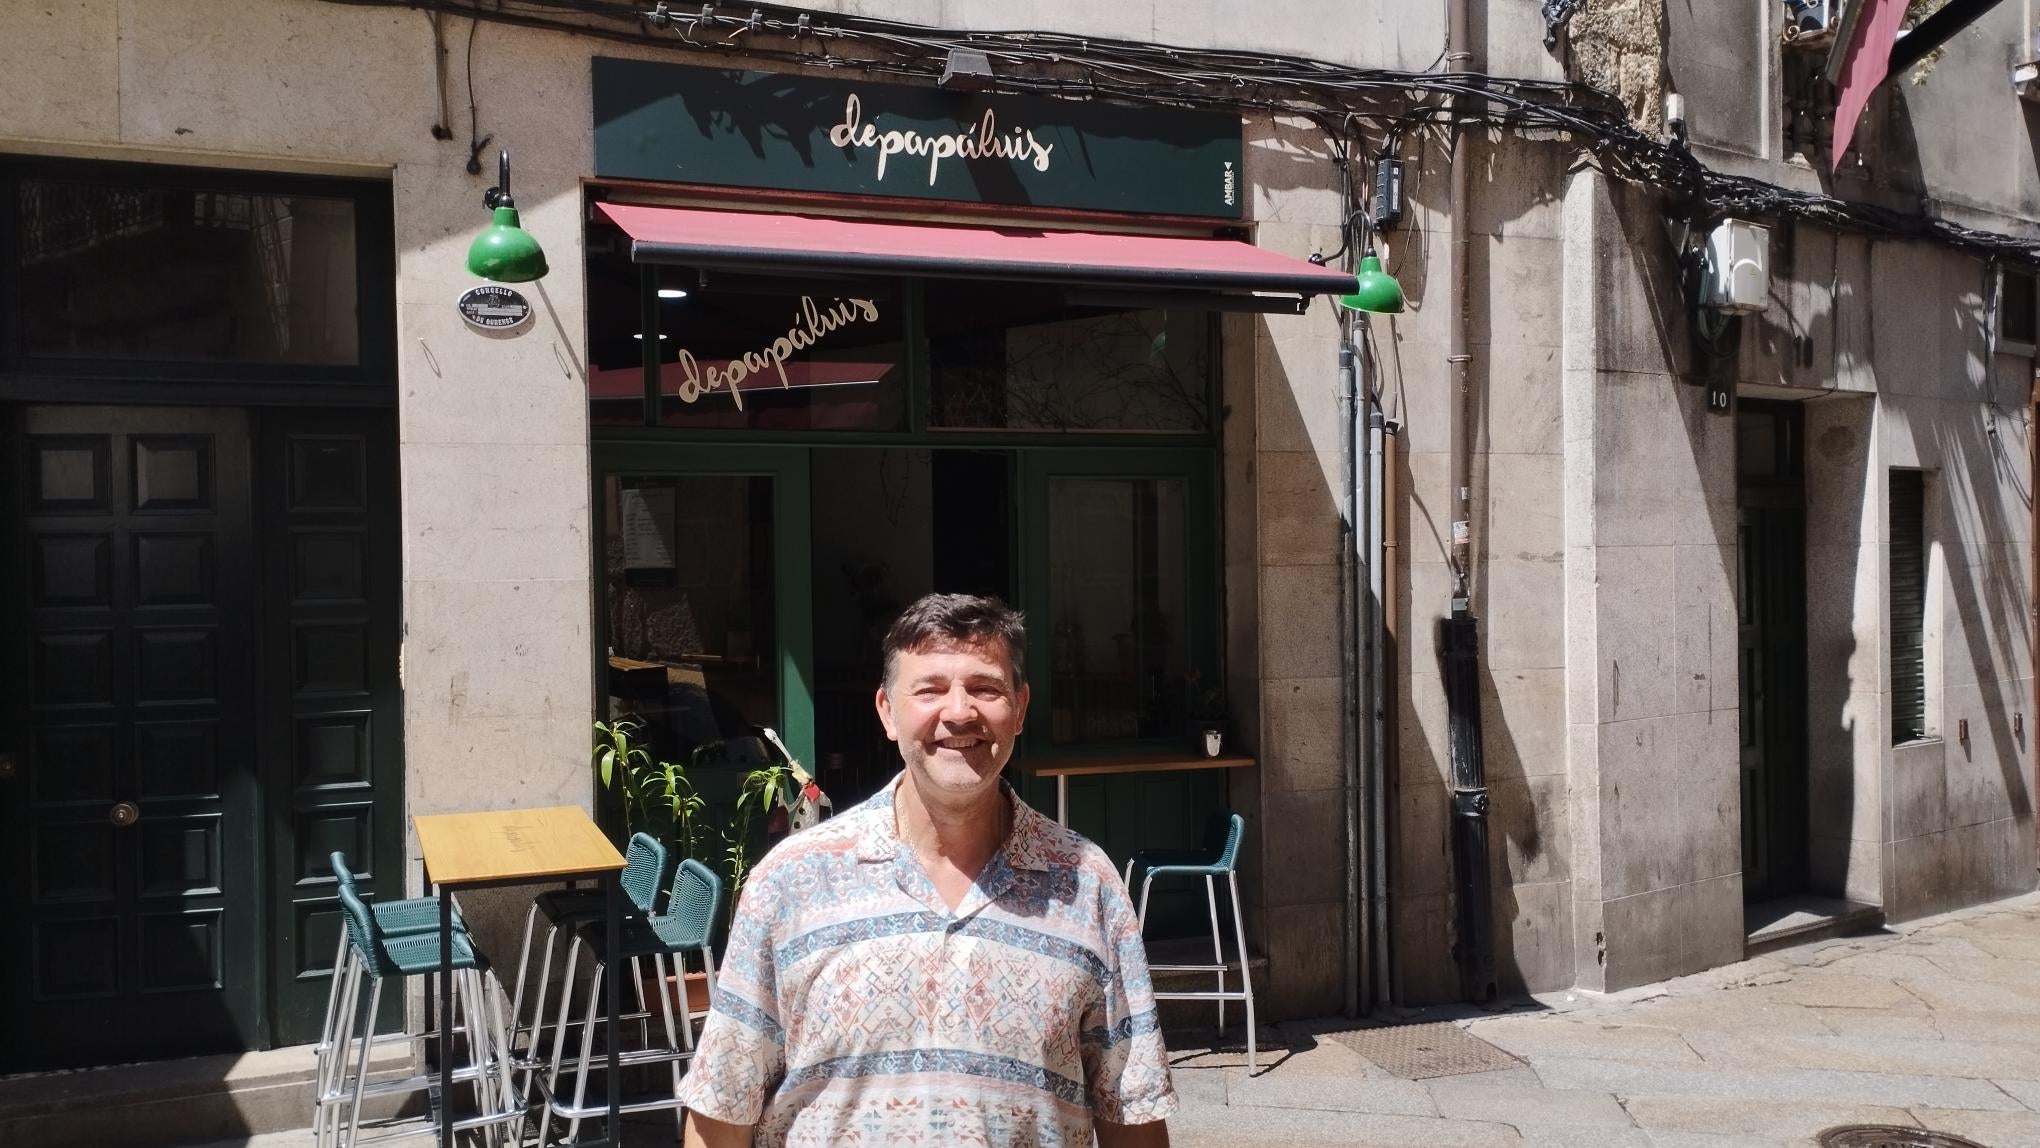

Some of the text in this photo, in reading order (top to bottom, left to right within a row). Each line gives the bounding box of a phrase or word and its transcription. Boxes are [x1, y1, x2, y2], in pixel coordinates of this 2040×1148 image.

[829, 93, 1053, 186] depapáluis
[1224, 169, 1232, 206] AMBAR
[475, 287, 512, 297] CONCELLO
[1712, 390, 1727, 408] 10
